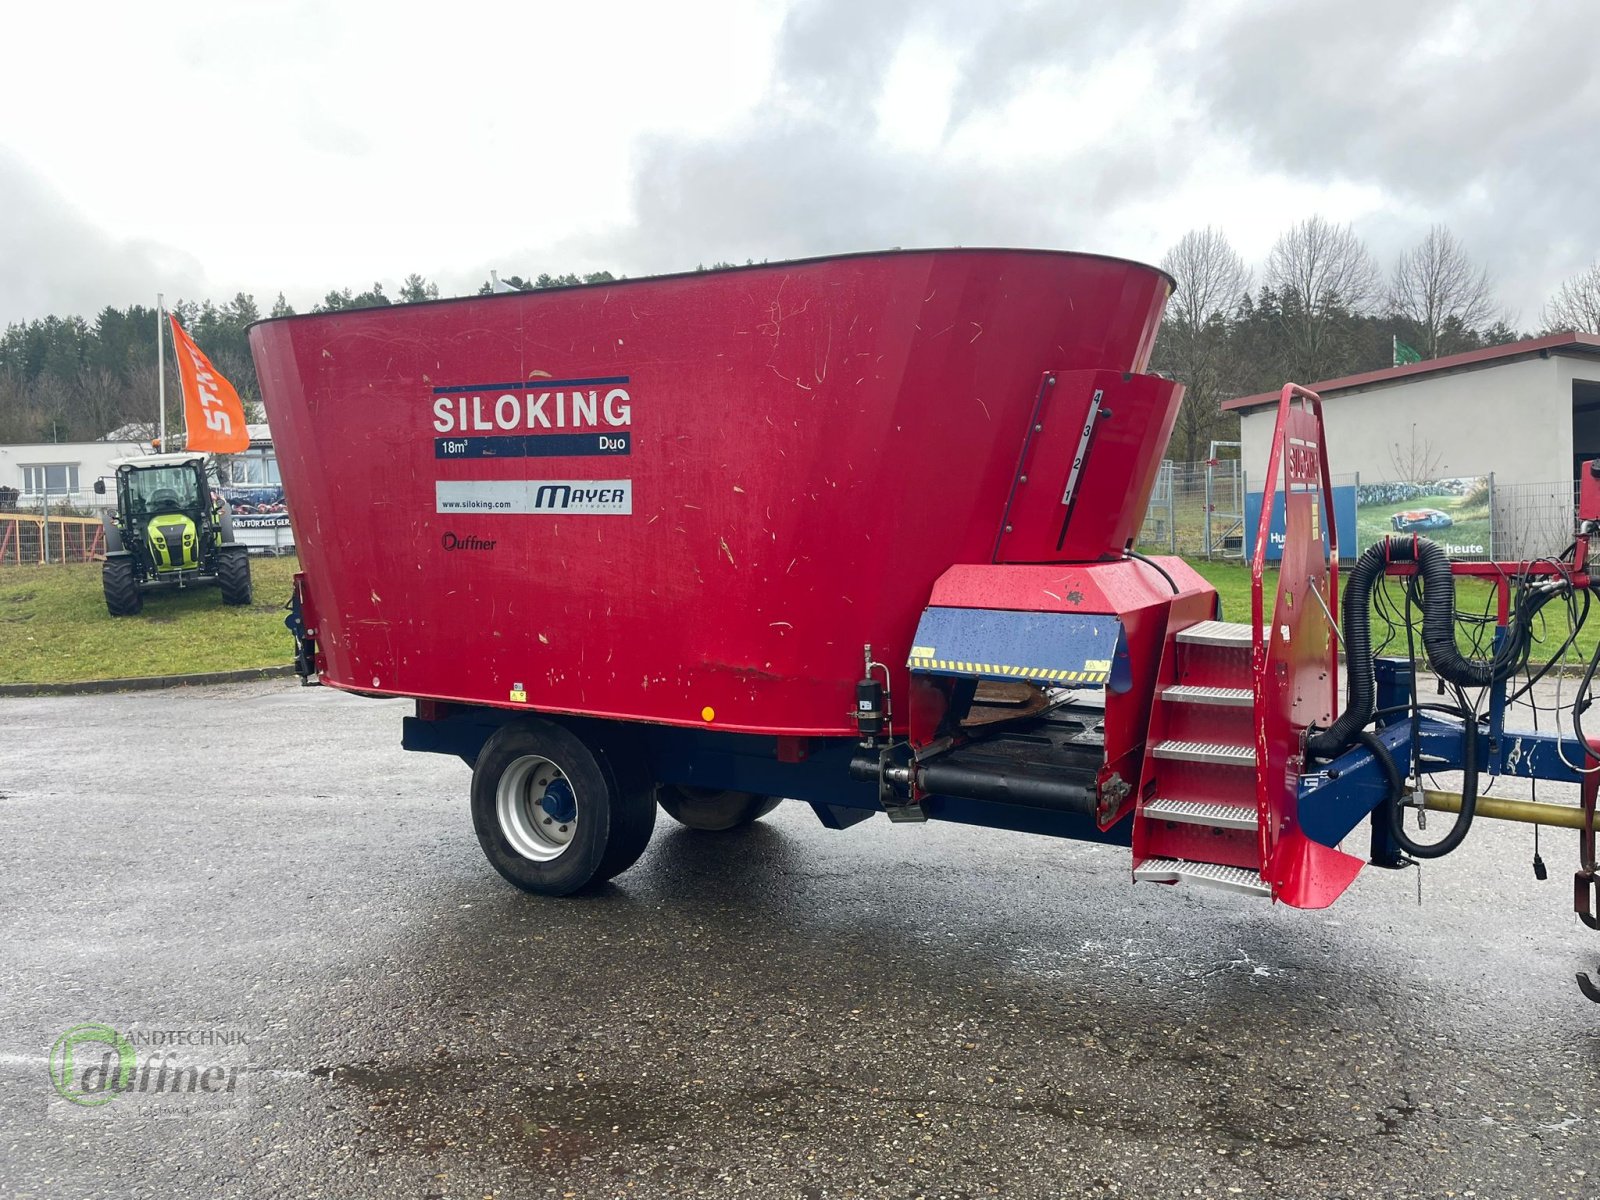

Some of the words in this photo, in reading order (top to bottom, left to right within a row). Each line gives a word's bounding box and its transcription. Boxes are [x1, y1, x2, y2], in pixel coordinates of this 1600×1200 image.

[1093, 393, 1101, 404] 4
[433, 388, 631, 432] SILOKING
[1083, 425, 1091, 436] 3
[599, 436, 626, 450] Duo
[1073, 458, 1080, 469] 2
[442, 501, 511, 509] www.siloking.com
[535, 485, 624, 508] MAYER
[1065, 490, 1070, 501] 1
[232, 520, 246, 528] KKU
[442, 532, 497, 551] Duffner
[1446, 543, 1483, 553] heute
